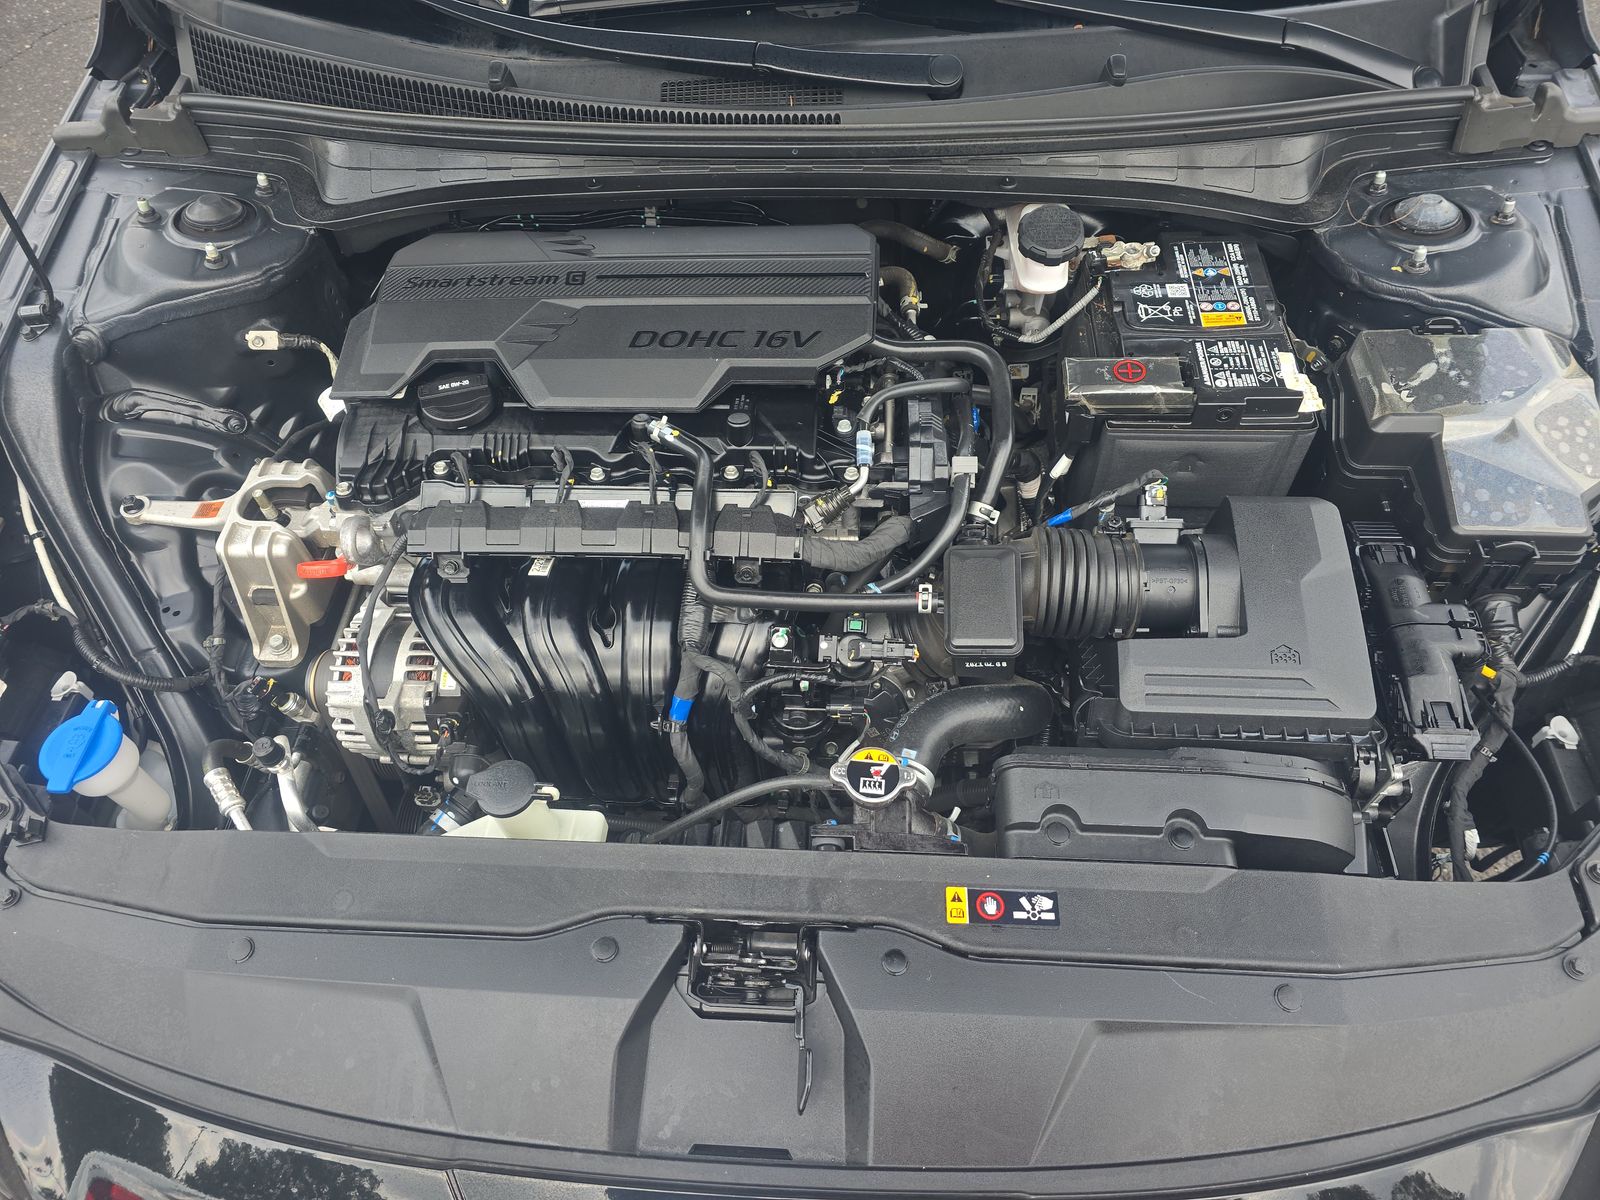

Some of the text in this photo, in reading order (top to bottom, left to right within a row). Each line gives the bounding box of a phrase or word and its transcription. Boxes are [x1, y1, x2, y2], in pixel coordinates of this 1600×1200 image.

[402, 274, 560, 289] Smartstream
[1172, 306, 1184, 316] Pb
[628, 330, 823, 349] DOHC 16V
